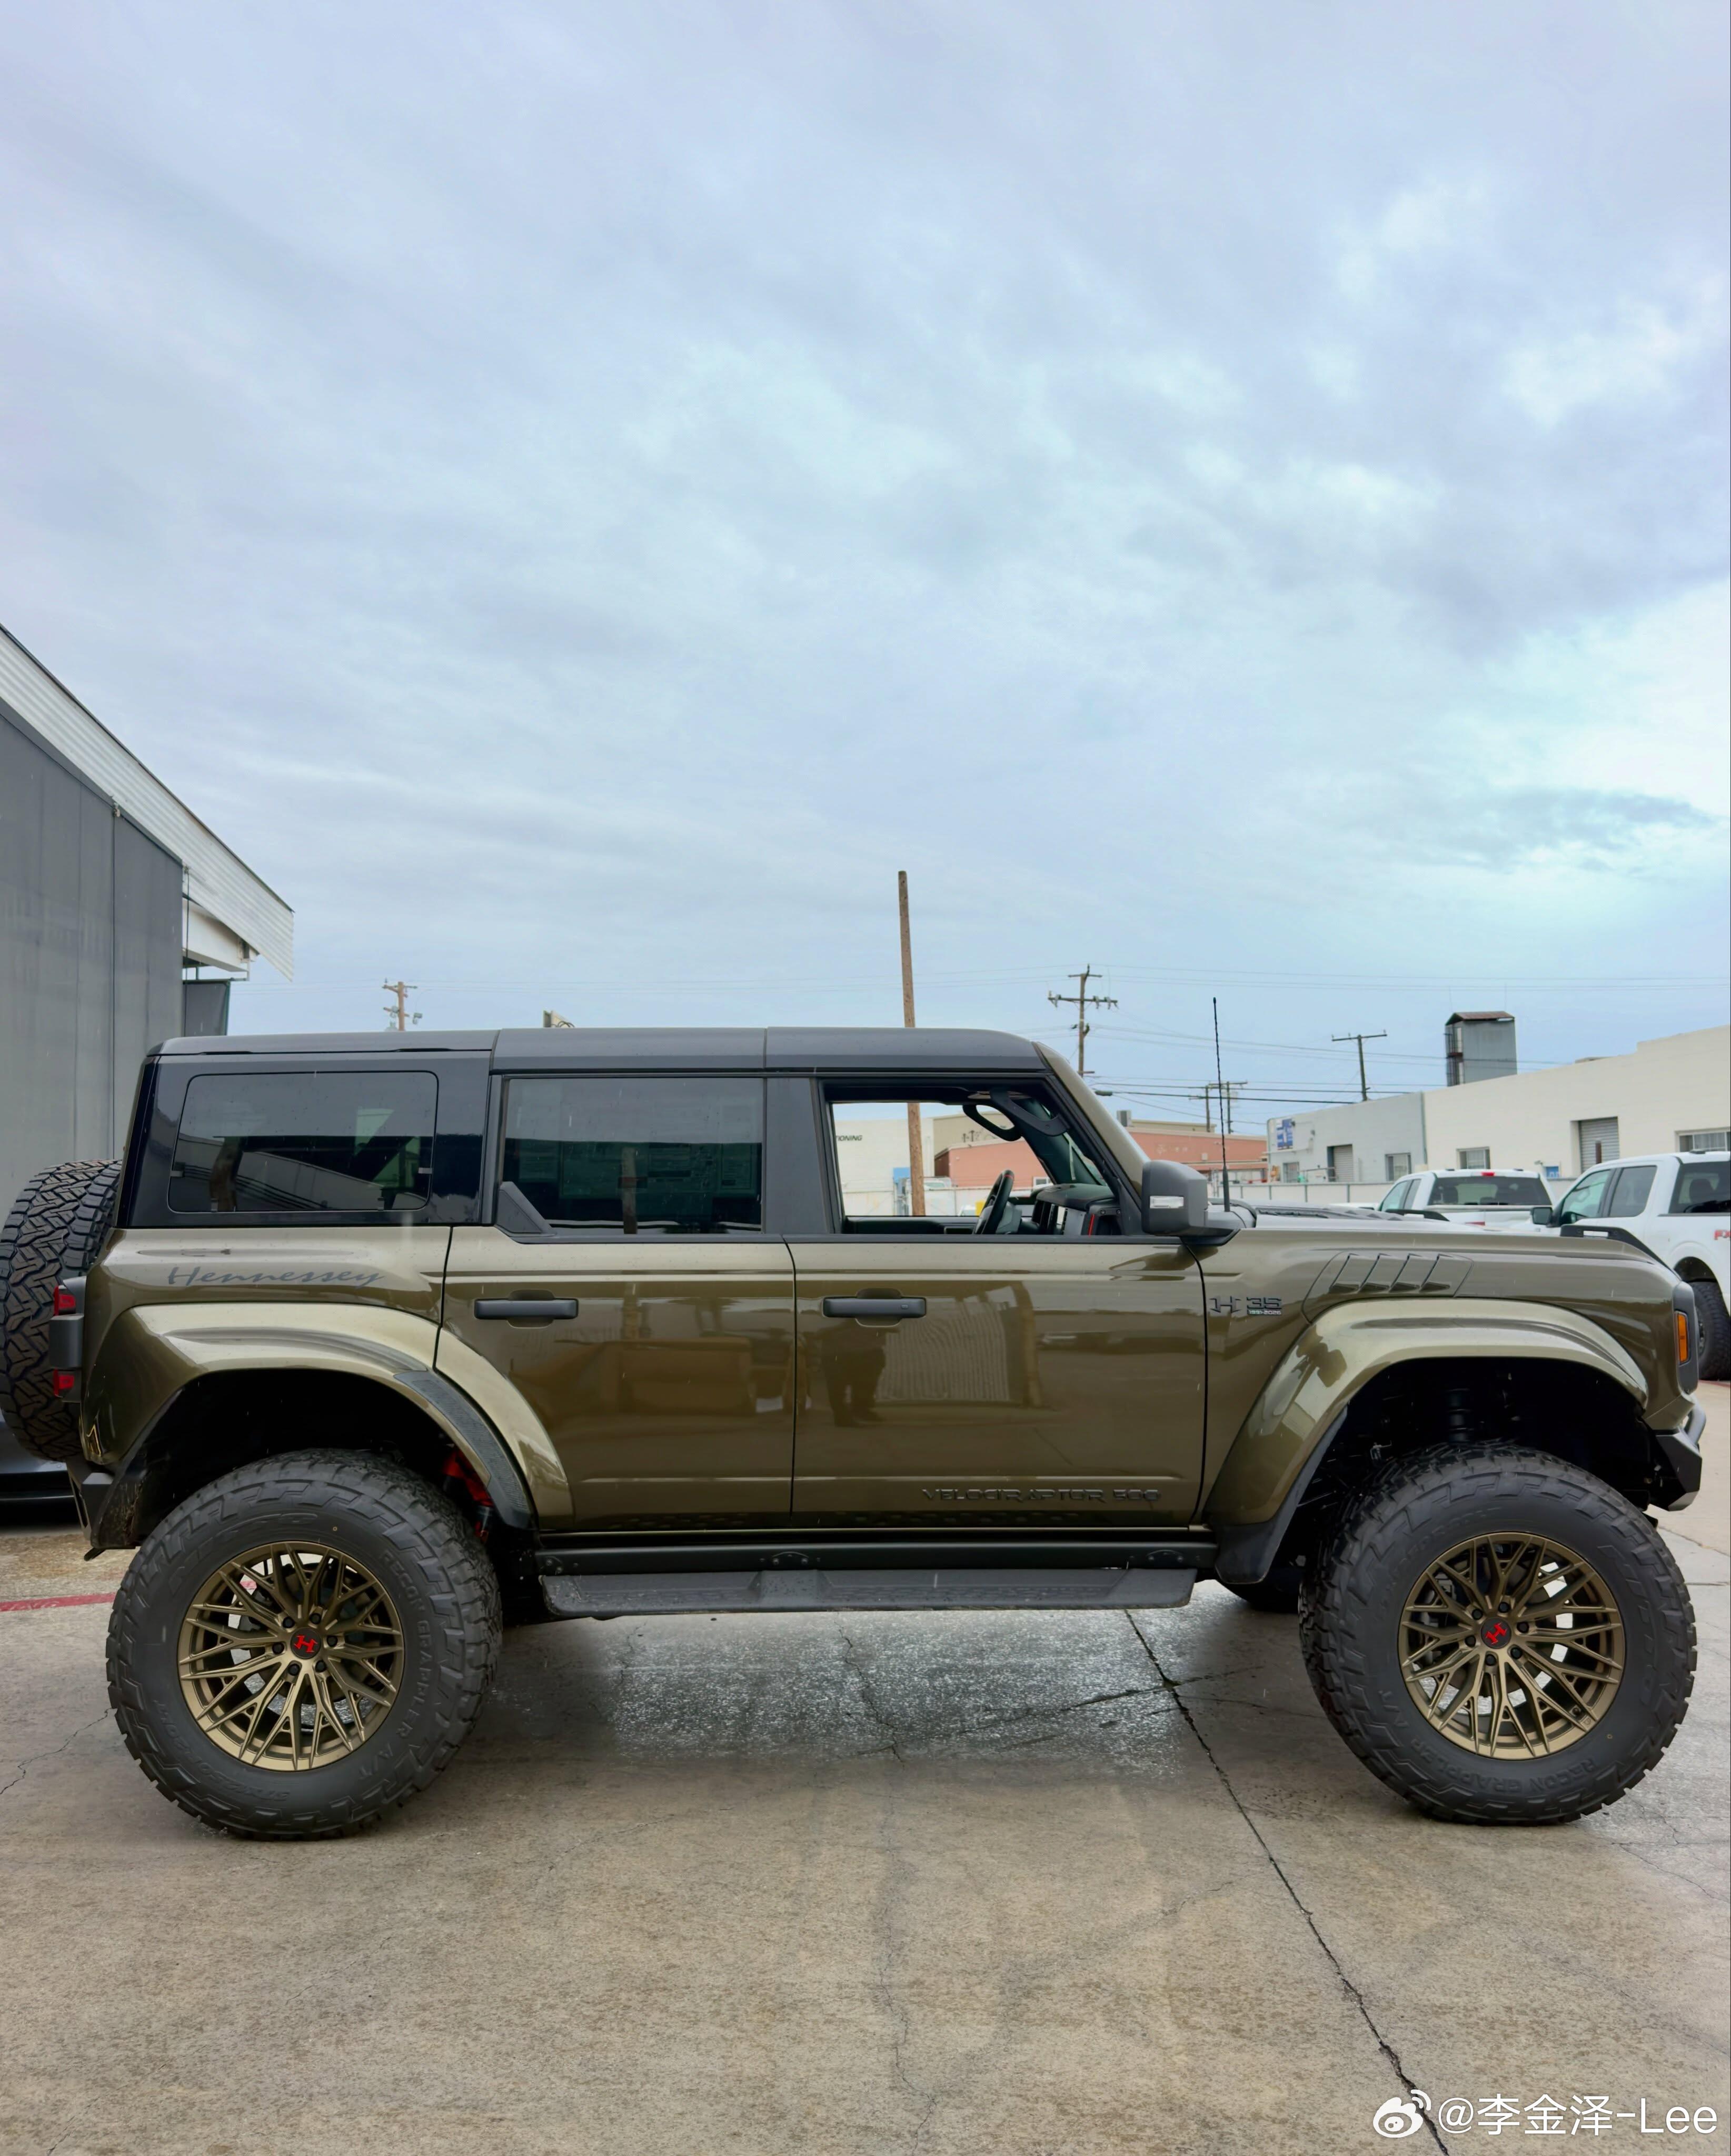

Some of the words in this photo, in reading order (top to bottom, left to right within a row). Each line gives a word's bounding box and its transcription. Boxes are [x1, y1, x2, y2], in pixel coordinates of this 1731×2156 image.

[167, 1266, 385, 1289] Hennessey
[1247, 1297, 1282, 1309] 35
[922, 1489, 1106, 1503] VELOCIRAPTOR
[1113, 1489, 1161, 1500] 500
[1411, 1738, 1522, 1792] GRAPPLER
[1529, 1759, 1597, 1791] RECON
